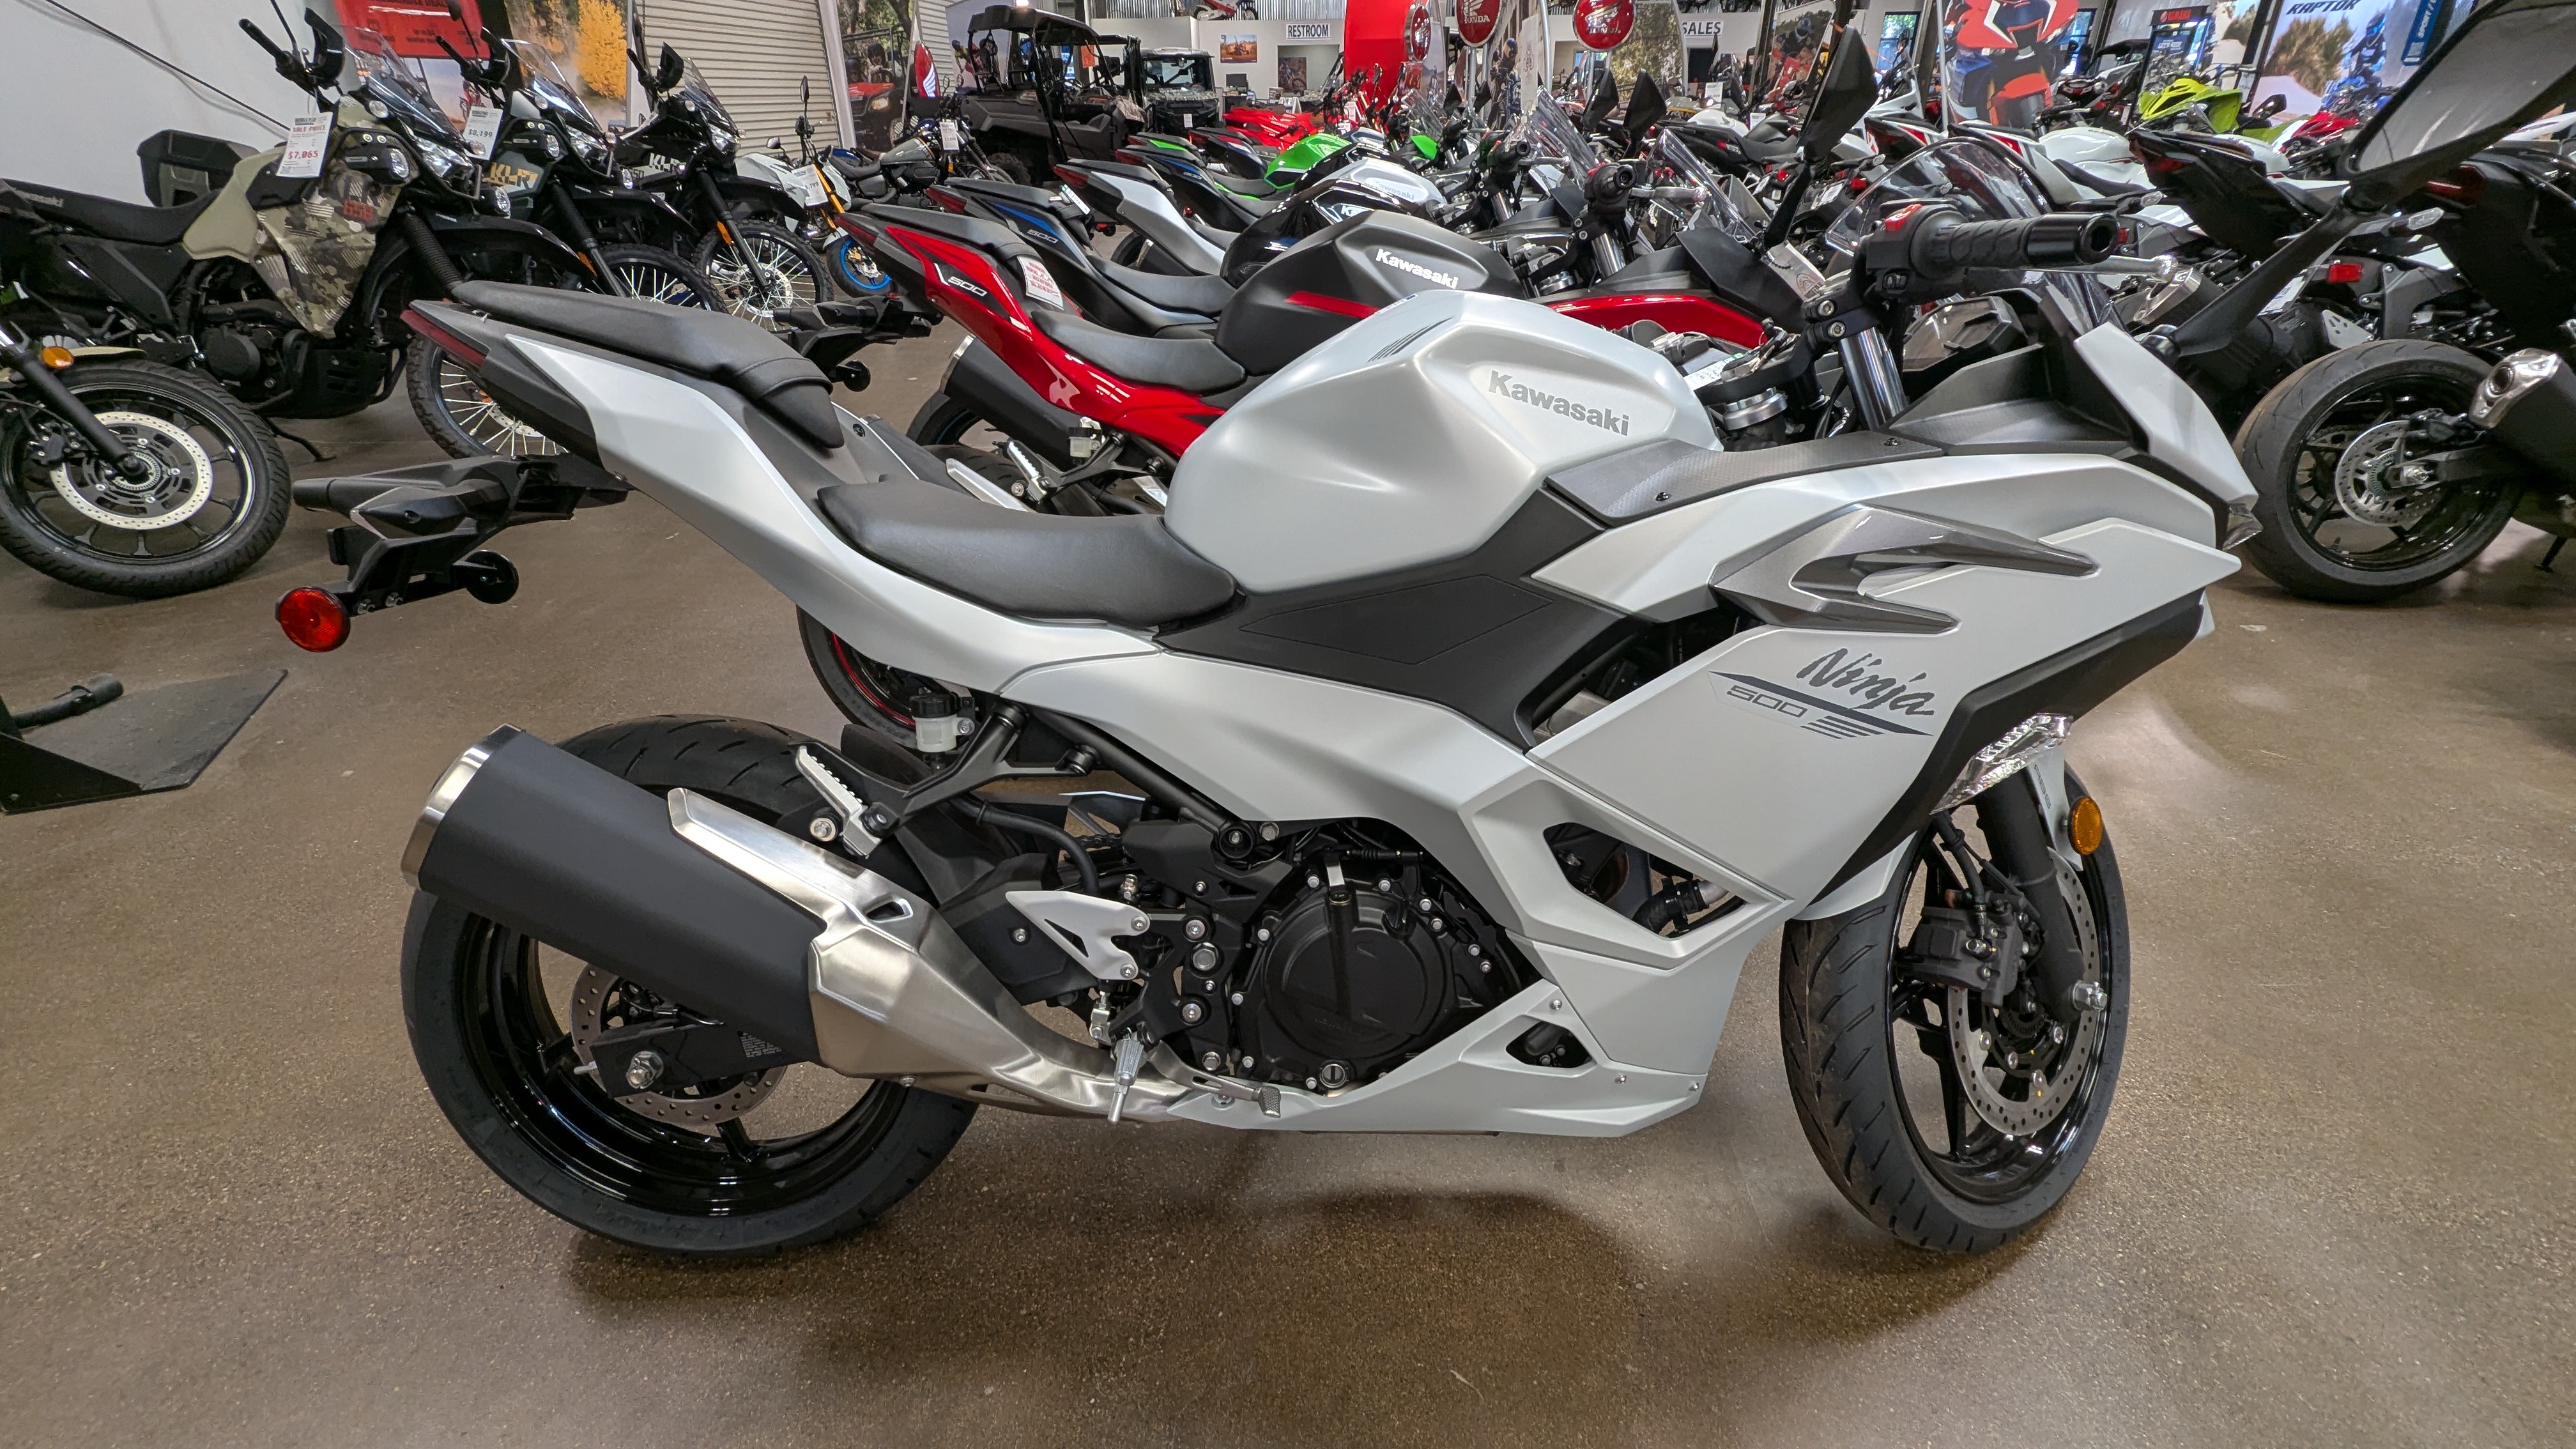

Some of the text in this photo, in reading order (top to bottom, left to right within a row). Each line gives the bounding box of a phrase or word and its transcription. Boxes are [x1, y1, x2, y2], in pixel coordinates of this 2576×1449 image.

[2286, 0, 2362, 15] RAPTOR
[1464, 15, 1491, 24] HONDA
[1682, 21, 1721, 34] SALES
[1287, 25, 1329, 37] RESTROOM
[649, 153, 687, 176] KLR
[489, 162, 539, 190] KLR
[1027, 229, 1059, 244] 500
[1376, 248, 1459, 289] Kawasaki
[947, 275, 988, 297] 500
[1489, 369, 1630, 436] Kawasaki
[1796, 647, 1935, 716] Ninja
[1726, 684, 1808, 718] 500
